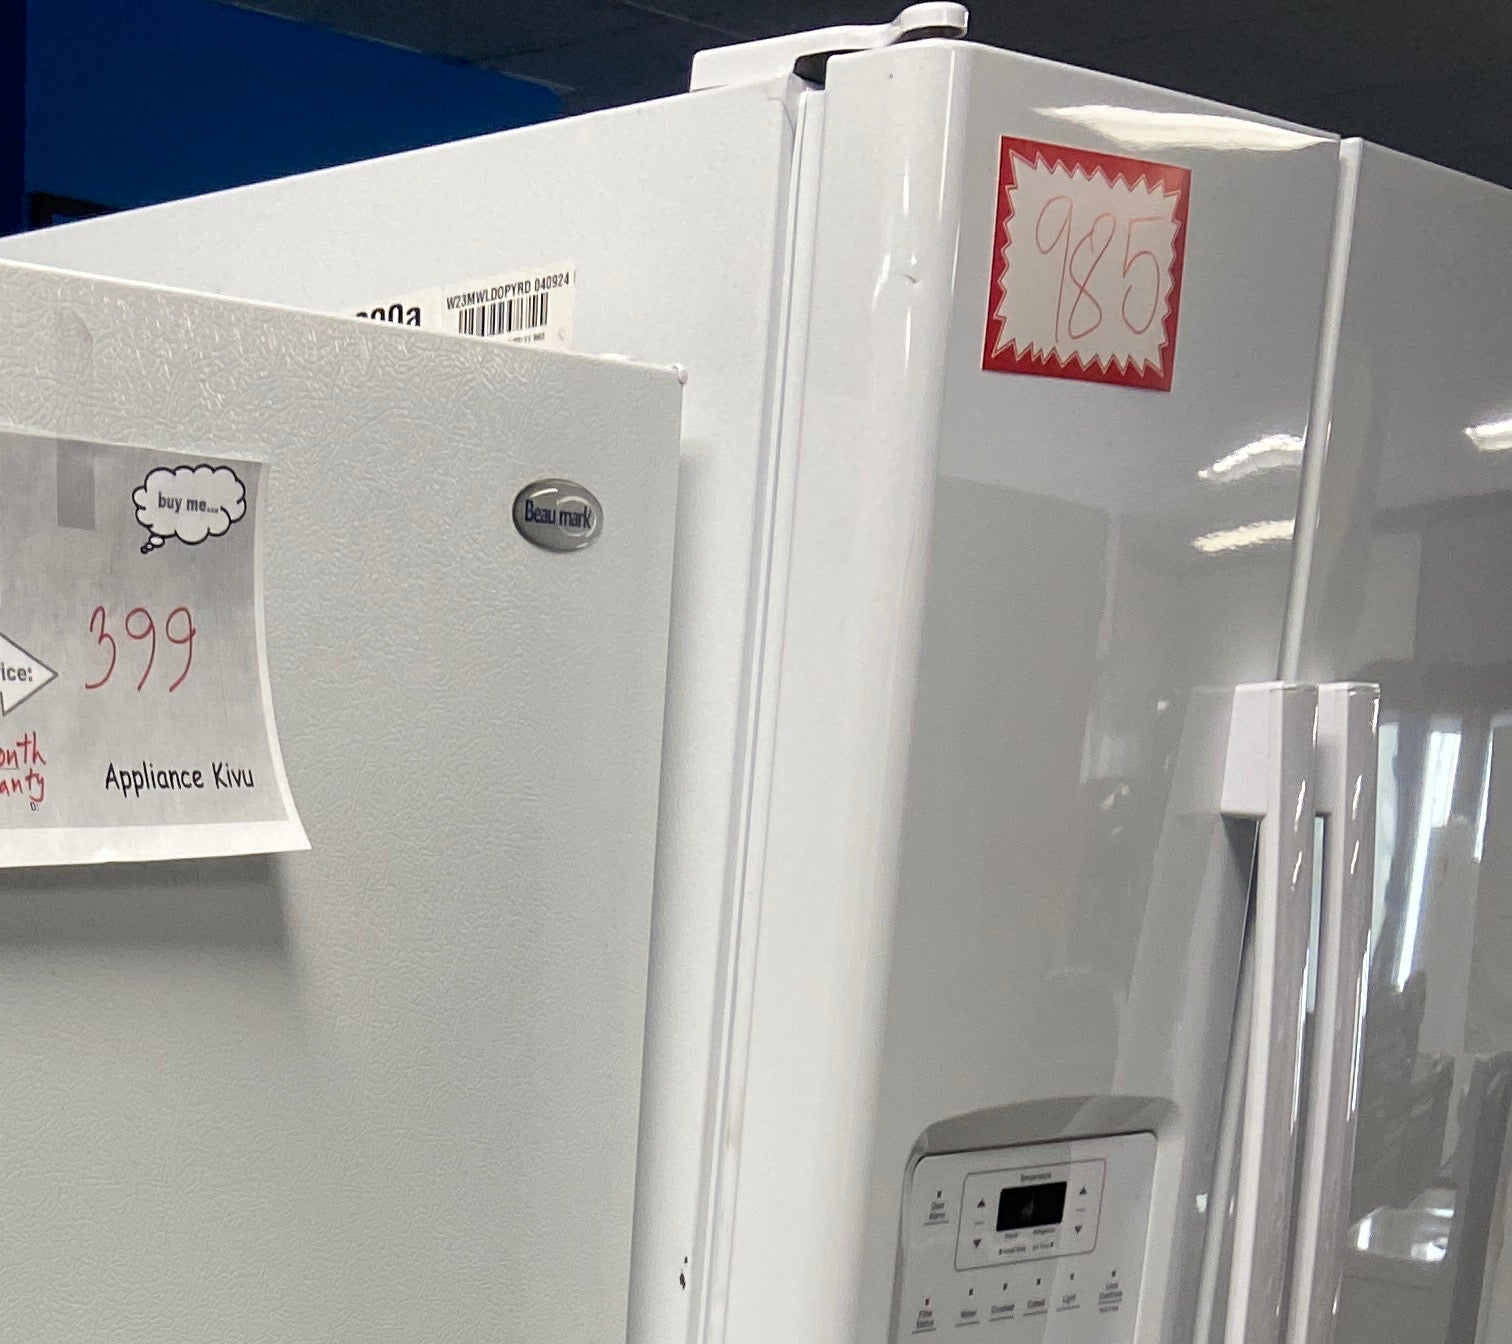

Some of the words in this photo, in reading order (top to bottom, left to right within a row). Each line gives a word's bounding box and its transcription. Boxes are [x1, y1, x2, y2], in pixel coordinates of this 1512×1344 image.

[533, 272, 571, 293] 040924
[1035, 195, 1167, 343] 985
[158, 491, 182, 513] buy
[524, 499, 556, 525] Beau
[559, 505, 592, 529] mark
[85, 606, 197, 693] 399
[105, 762, 205, 798] Appliance
[211, 762, 254, 789] Kivu
